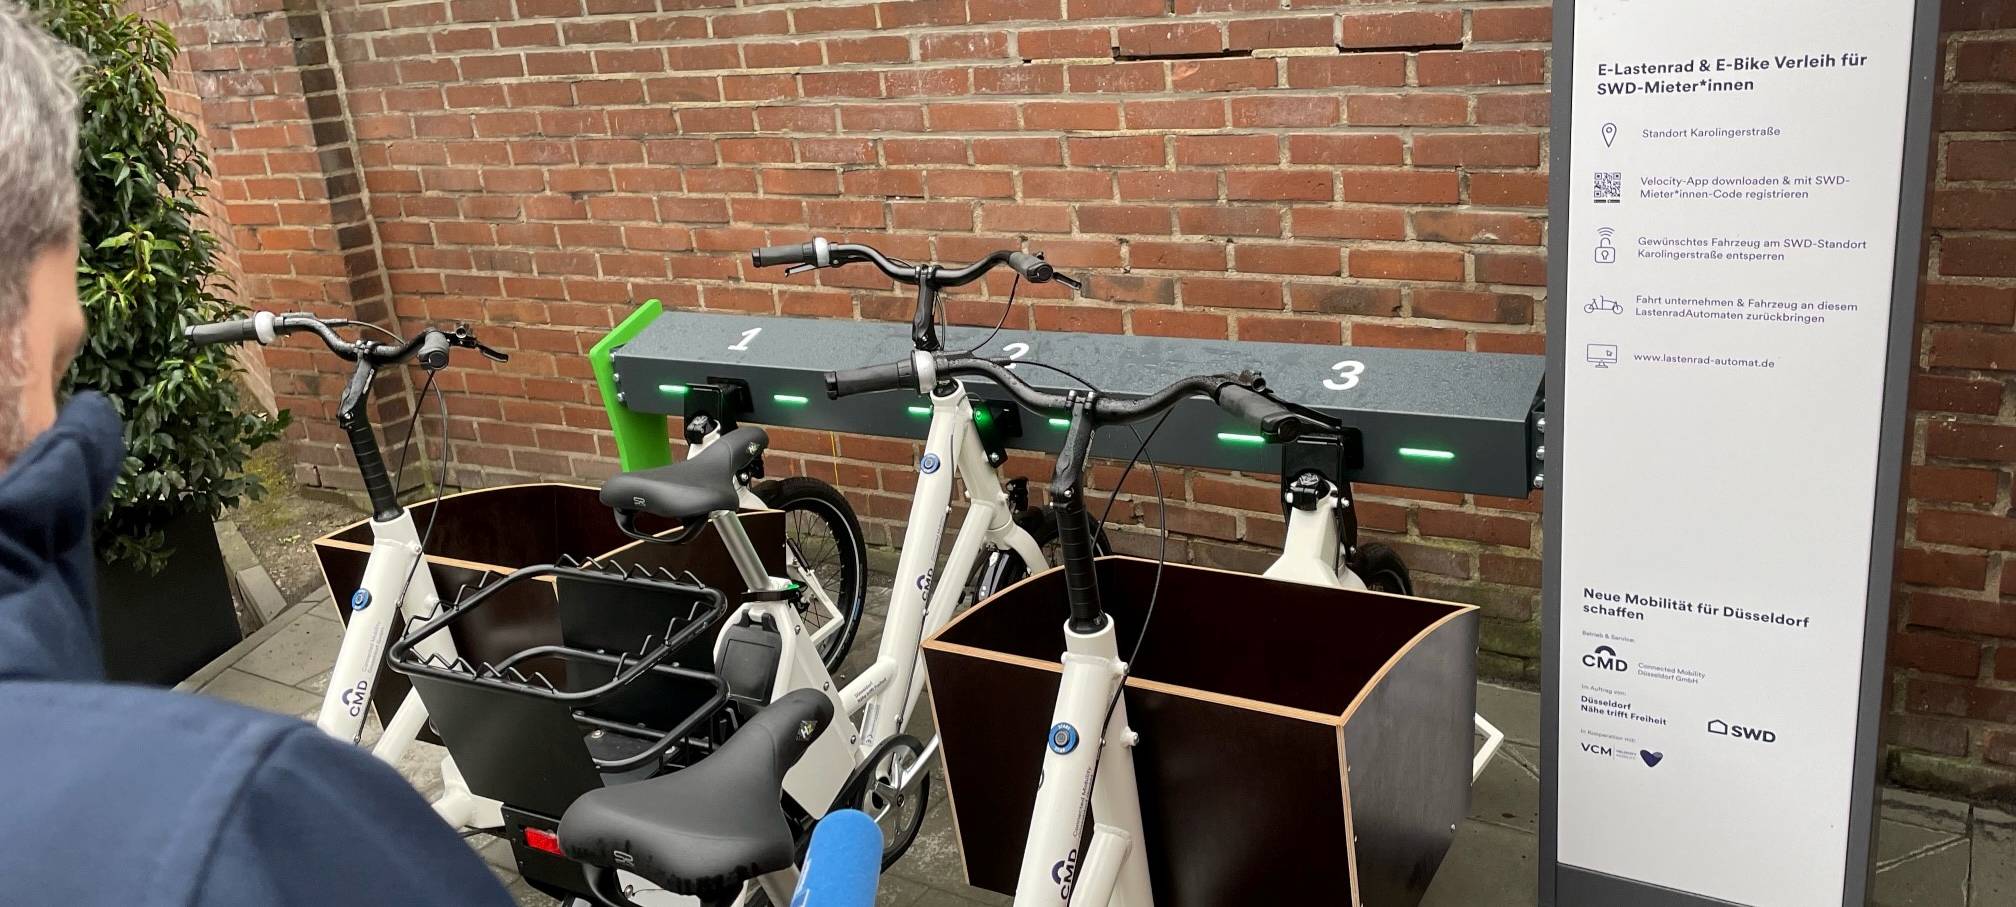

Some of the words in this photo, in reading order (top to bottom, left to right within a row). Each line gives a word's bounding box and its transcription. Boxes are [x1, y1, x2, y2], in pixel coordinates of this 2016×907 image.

[1598, 60, 1694, 76] E-Lastenrad
[1699, 59, 1711, 72] &
[1716, 57, 1770, 72] E-Bike
[1774, 54, 1836, 69] Verleih
[1841, 52, 1868, 67] für
[1642, 128, 1687, 138] Standort
[1690, 126, 1781, 139] Karolingerstraße
[1640, 176, 1709, 188] Velocity-App
[1712, 176, 1779, 186] downloaden
[1782, 176, 1790, 186] &
[1794, 176, 1812, 186] mit
[1815, 176, 1850, 186] SWD-
[1746, 188, 1809, 200] registrieren
[1638, 236, 1708, 248] Gewünschtes
[1711, 238, 1760, 250] Fahrzeug
[1764, 240, 1780, 248] am
[1784, 239, 1867, 250] SWD-Standort
[1638, 249, 1723, 260] Karolingerstraße
[1726, 252, 1784, 262] entsperren
[1636, 295, 1662, 305] Fahrt
[1664, 297, 1734, 308] unternehmen
[1737, 298, 1744, 308] &
[1748, 298, 1798, 312] Fahrzeug
[1800, 302, 1814, 310] an
[1818, 300, 1858, 312] diesem
[1635, 308, 1743, 320] LastenradAutomaten
[1746, 311, 1825, 324] zurückbringen
[728, 327, 762, 352] 1
[1634, 353, 1775, 368] www.lastenrad-automat.de
[1322, 360, 1365, 390] 3
[1583, 604, 1644, 621] schaffen
[1584, 588, 1621, 603] Neue
[1625, 593, 1692, 613] Mobilität
[1697, 601, 1720, 616] für
[1722, 606, 1810, 628] Düsseldorf
[1582, 654, 1628, 672] CMD
[1638, 662, 1676, 674] Connected
[1677, 668, 1706, 680] Mobility
[1638, 670, 1674, 680] Düsseldorf
[1676, 676, 1698, 684] GmbH
[350, 680, 368, 717] CMD
[1580, 695, 1632, 710] Düsseldorf
[1580, 704, 1604, 715] Nähe
[1606, 708, 1628, 719] trifft
[1630, 714, 1667, 726] Freiheit
[1731, 725, 1776, 743] SWD
[1580, 742, 1612, 757] VCM
[1060, 849, 1077, 901] CMD
